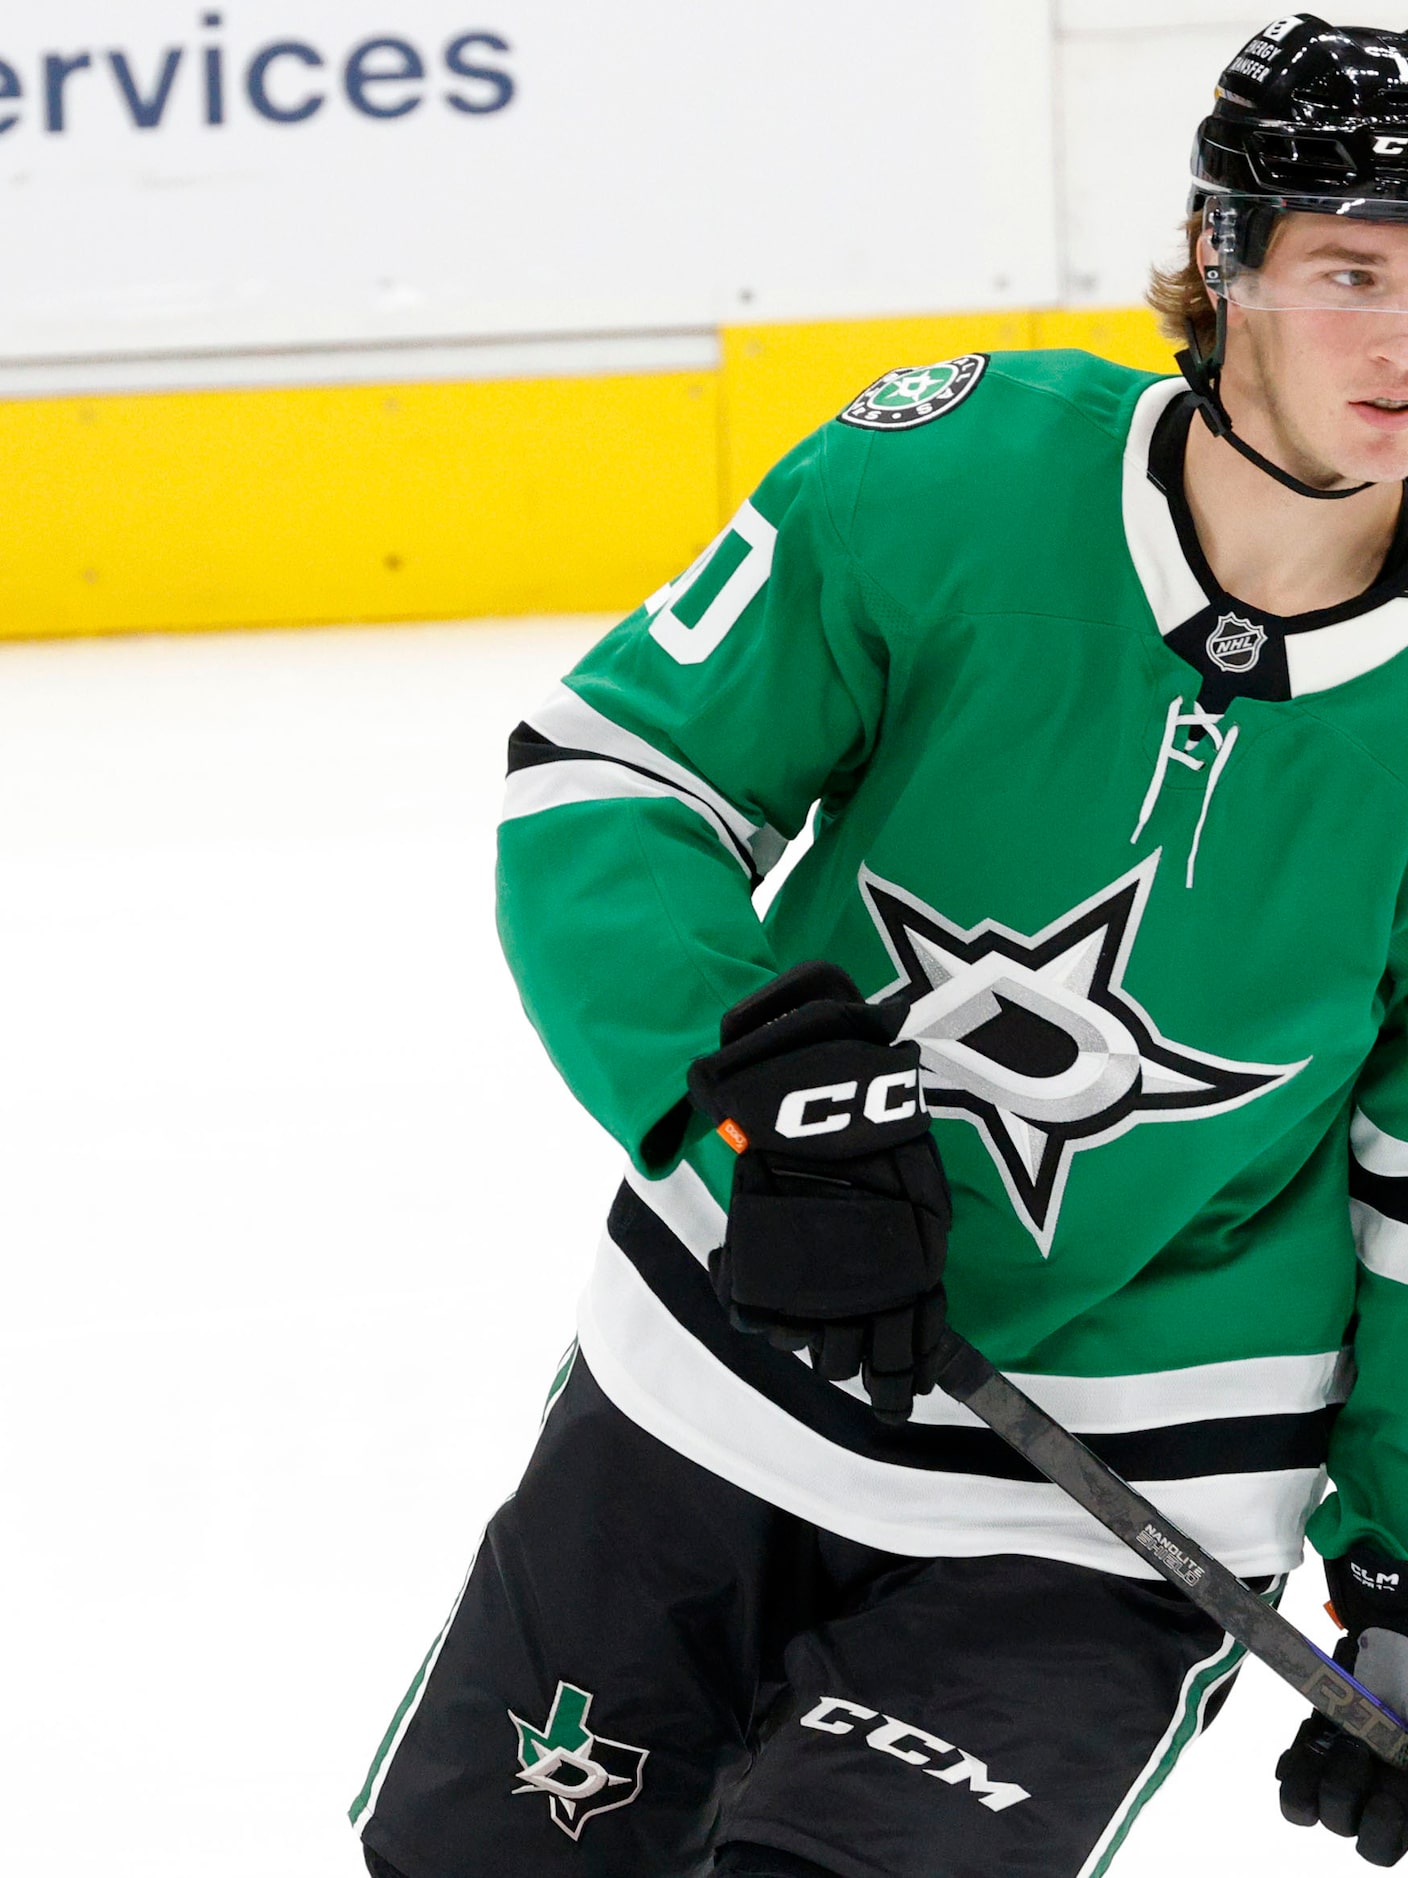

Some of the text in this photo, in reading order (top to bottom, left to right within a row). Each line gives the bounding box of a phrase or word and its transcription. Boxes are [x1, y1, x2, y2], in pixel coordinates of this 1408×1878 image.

[0, 12, 516, 134] rvices
[916, 357, 976, 415] ALLAS
[1215, 636, 1254, 655] NHL
[774, 1068, 928, 1139] CC
[1135, 1530, 1200, 1587] SHIELD
[1144, 1523, 1205, 1577] NANOLITE
[800, 1696, 1032, 1813] CCM
